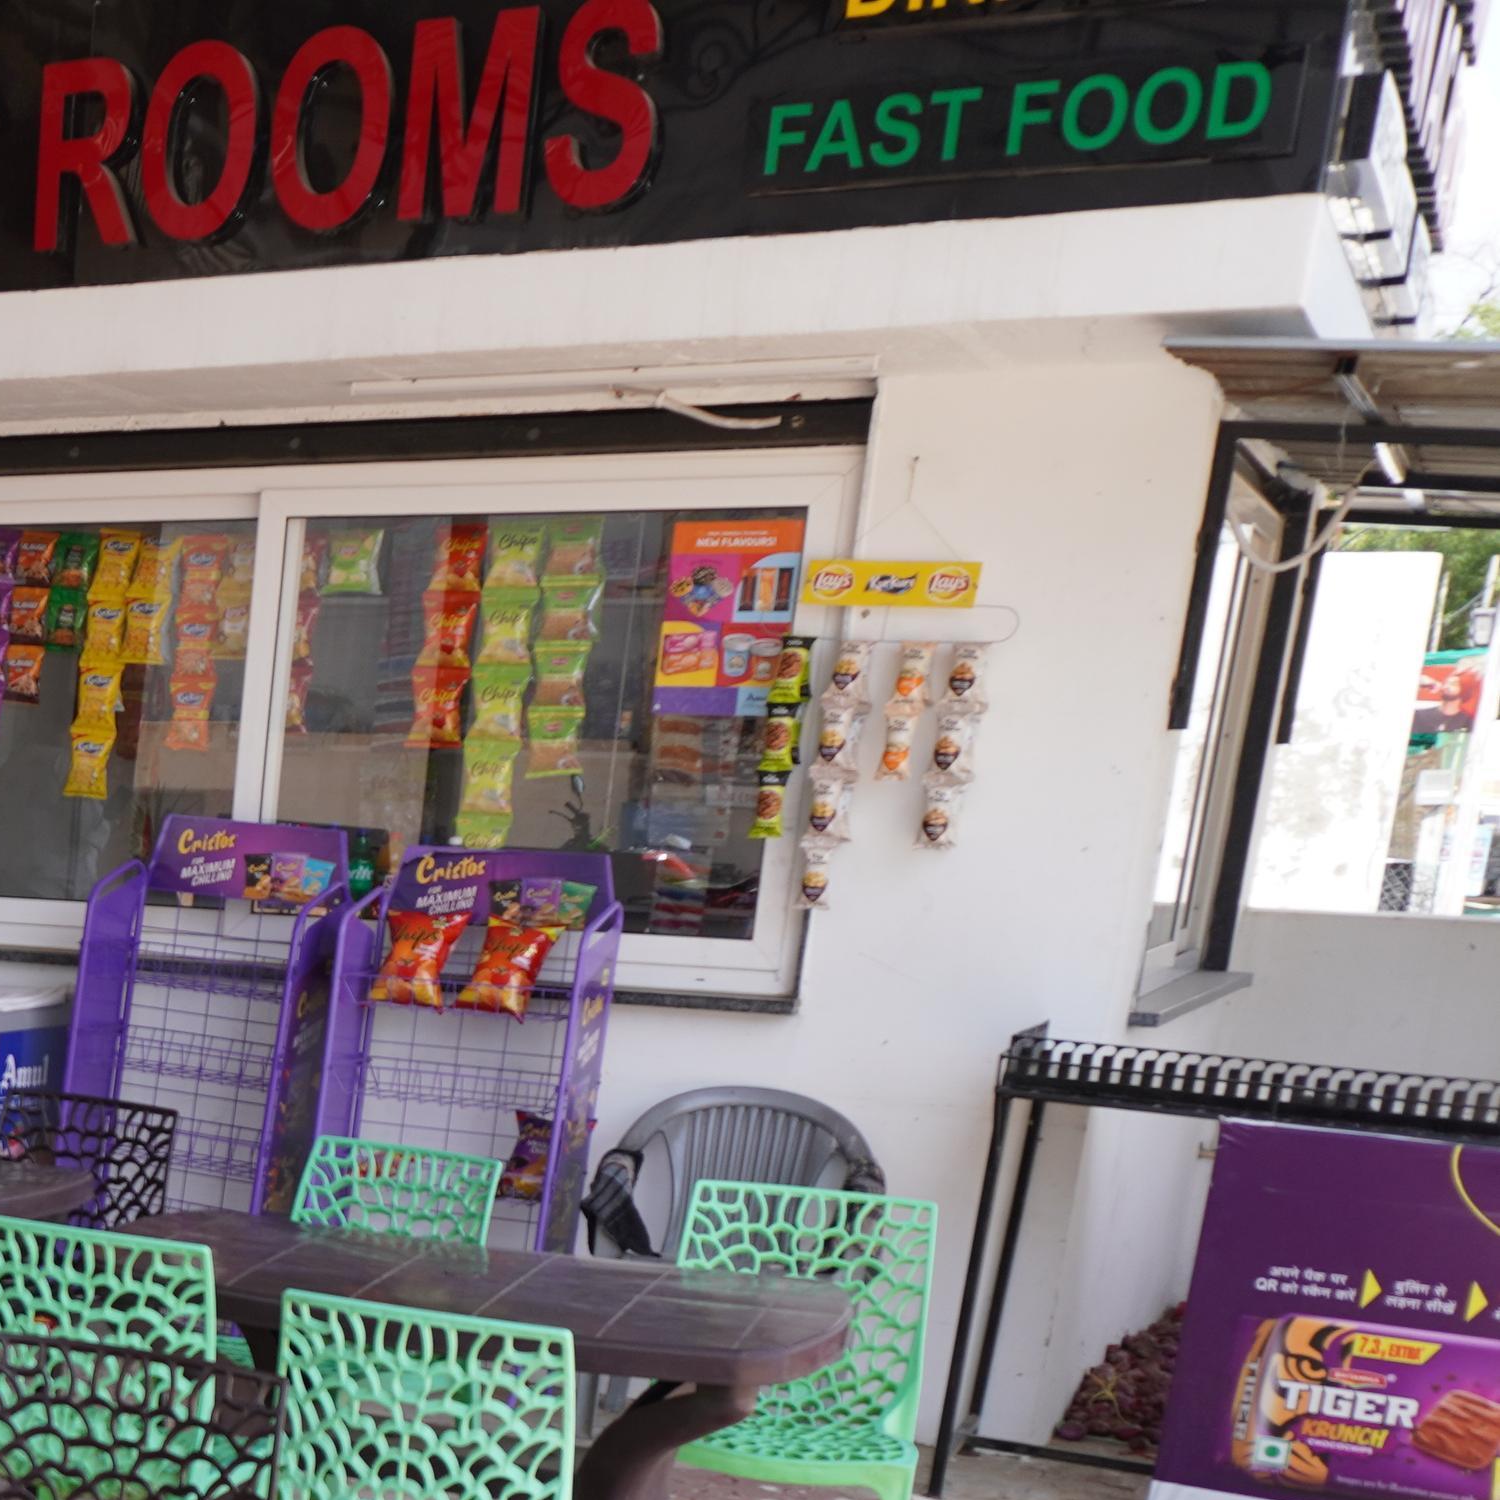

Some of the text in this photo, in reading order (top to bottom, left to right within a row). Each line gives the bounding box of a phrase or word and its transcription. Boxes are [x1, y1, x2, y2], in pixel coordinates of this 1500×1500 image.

[34, 0, 661, 252] ROOMS
[763, 61, 1273, 176] FAST FOOD
[1255, 1277, 1278, 1293] QR
[1277, 1379, 1419, 1429] TIGER
[1301, 1418, 1389, 1448] KRUNCH
